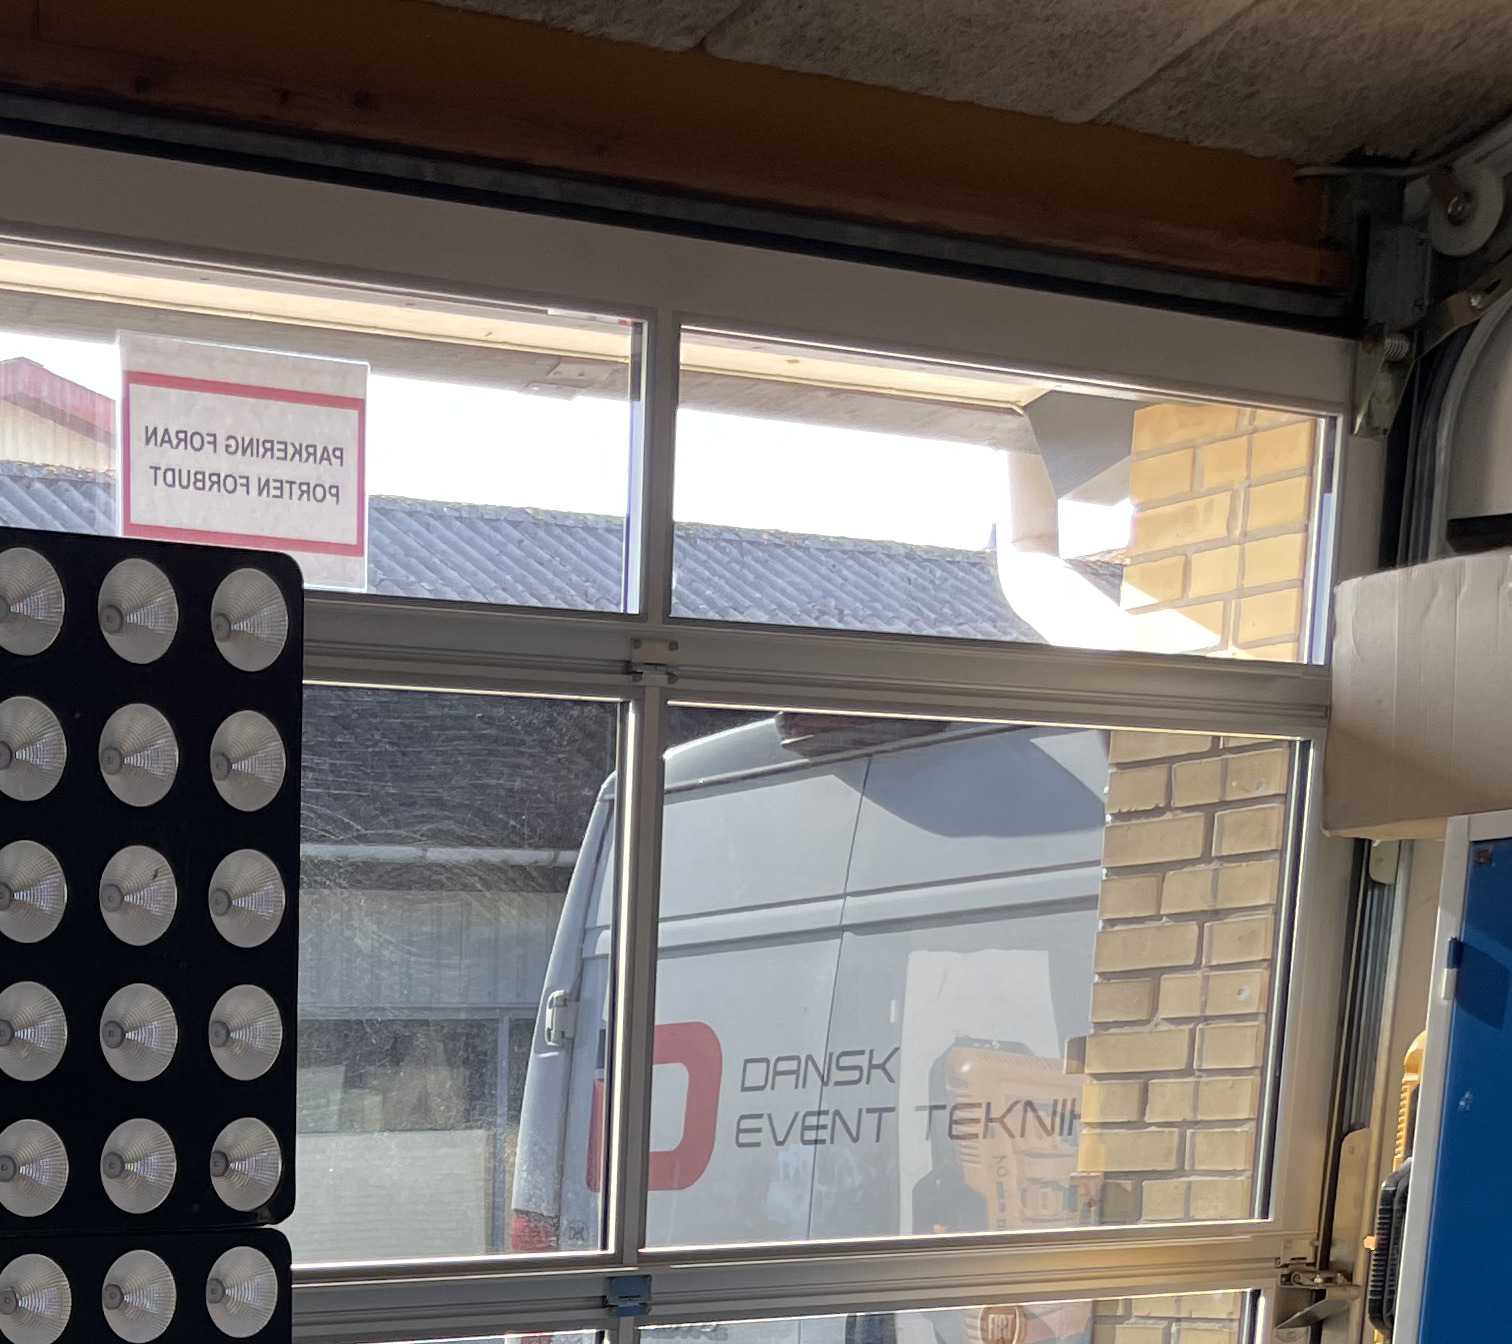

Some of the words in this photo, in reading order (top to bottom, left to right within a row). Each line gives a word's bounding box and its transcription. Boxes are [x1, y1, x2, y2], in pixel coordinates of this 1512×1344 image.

[740, 1047, 901, 1092] DANSK
[735, 1106, 896, 1148] EVENT
[988, 1313, 1016, 1340] FIAT
